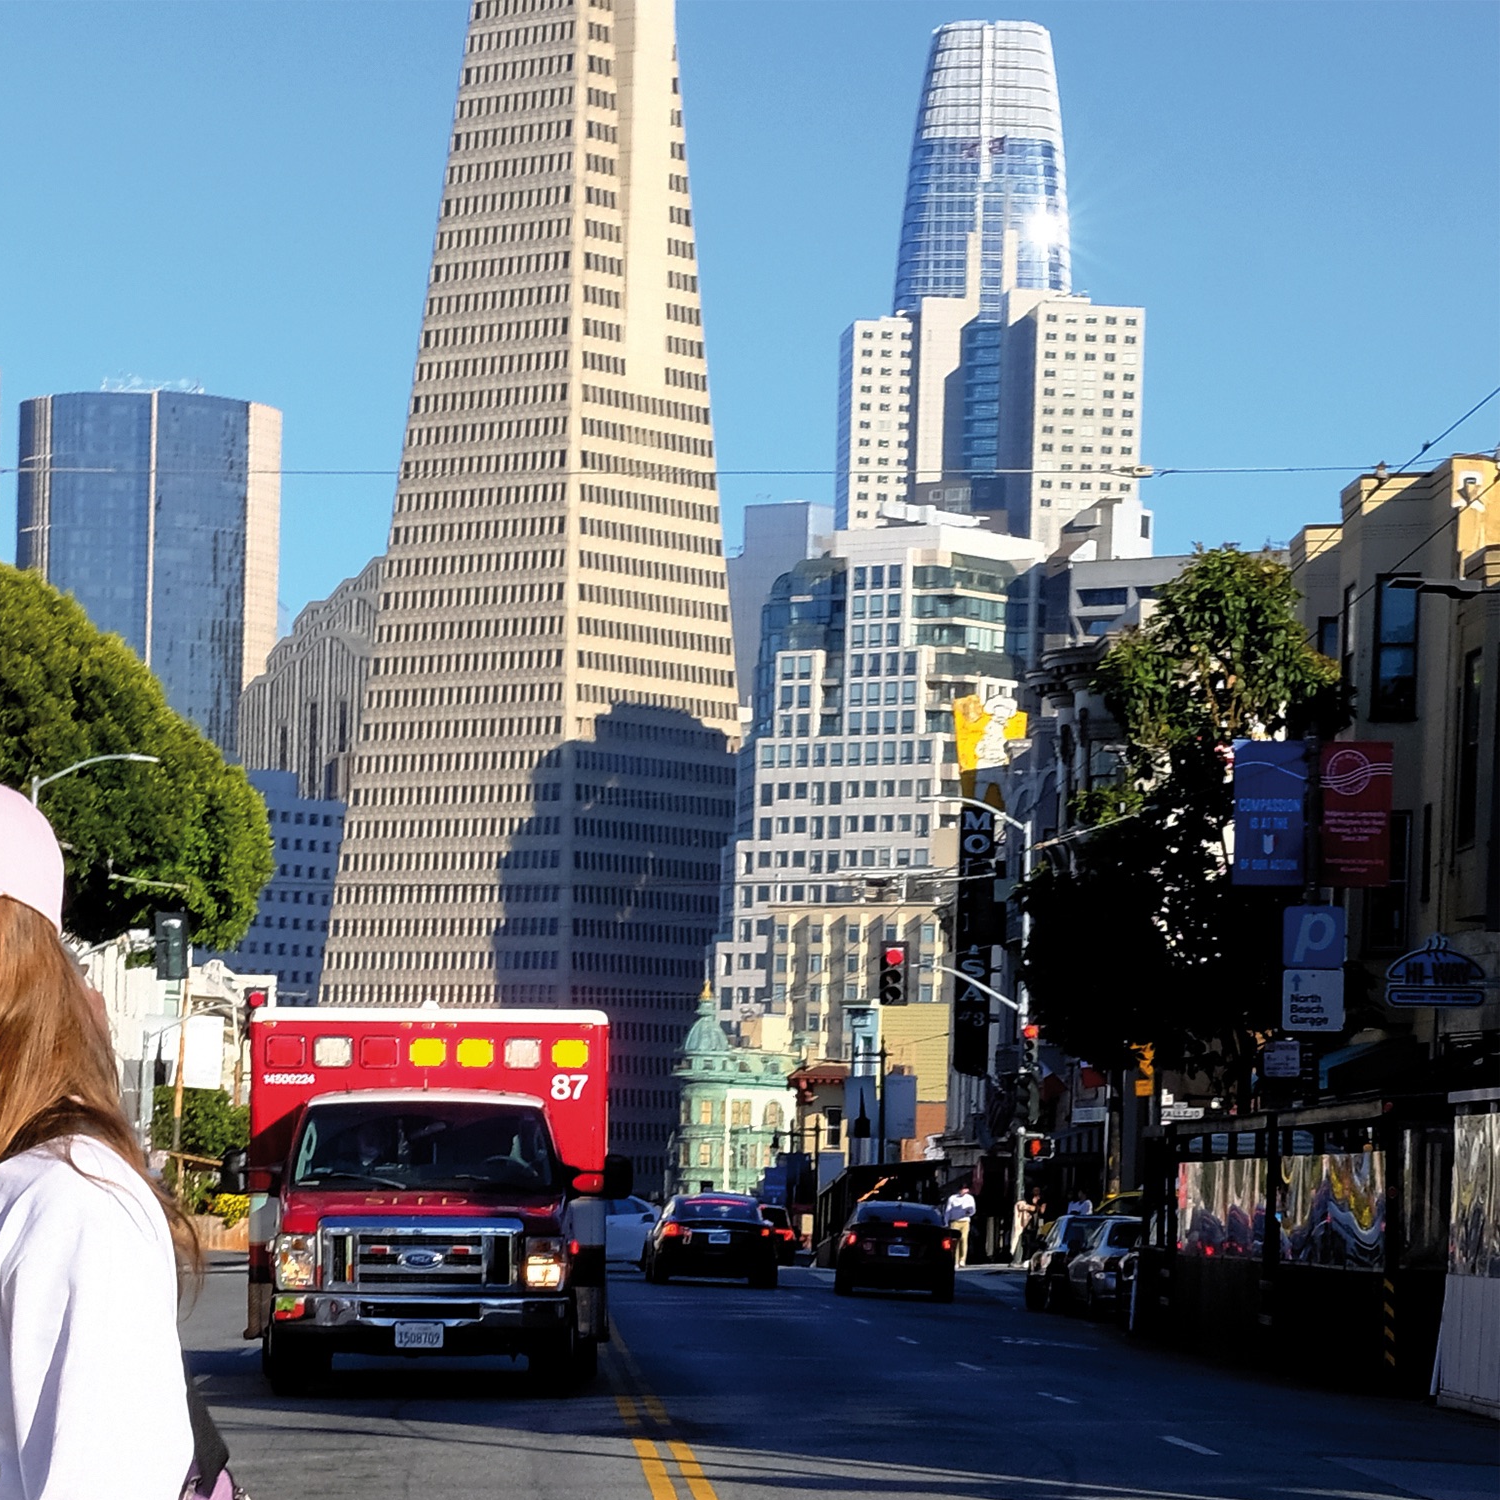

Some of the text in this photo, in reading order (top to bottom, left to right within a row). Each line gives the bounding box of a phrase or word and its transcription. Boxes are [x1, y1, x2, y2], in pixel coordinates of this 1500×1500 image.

[1290, 994, 1322, 1003] North
[1290, 1004, 1324, 1014] Beach
[1290, 1014, 1329, 1026] Garage
[551, 1074, 589, 1100] 87
